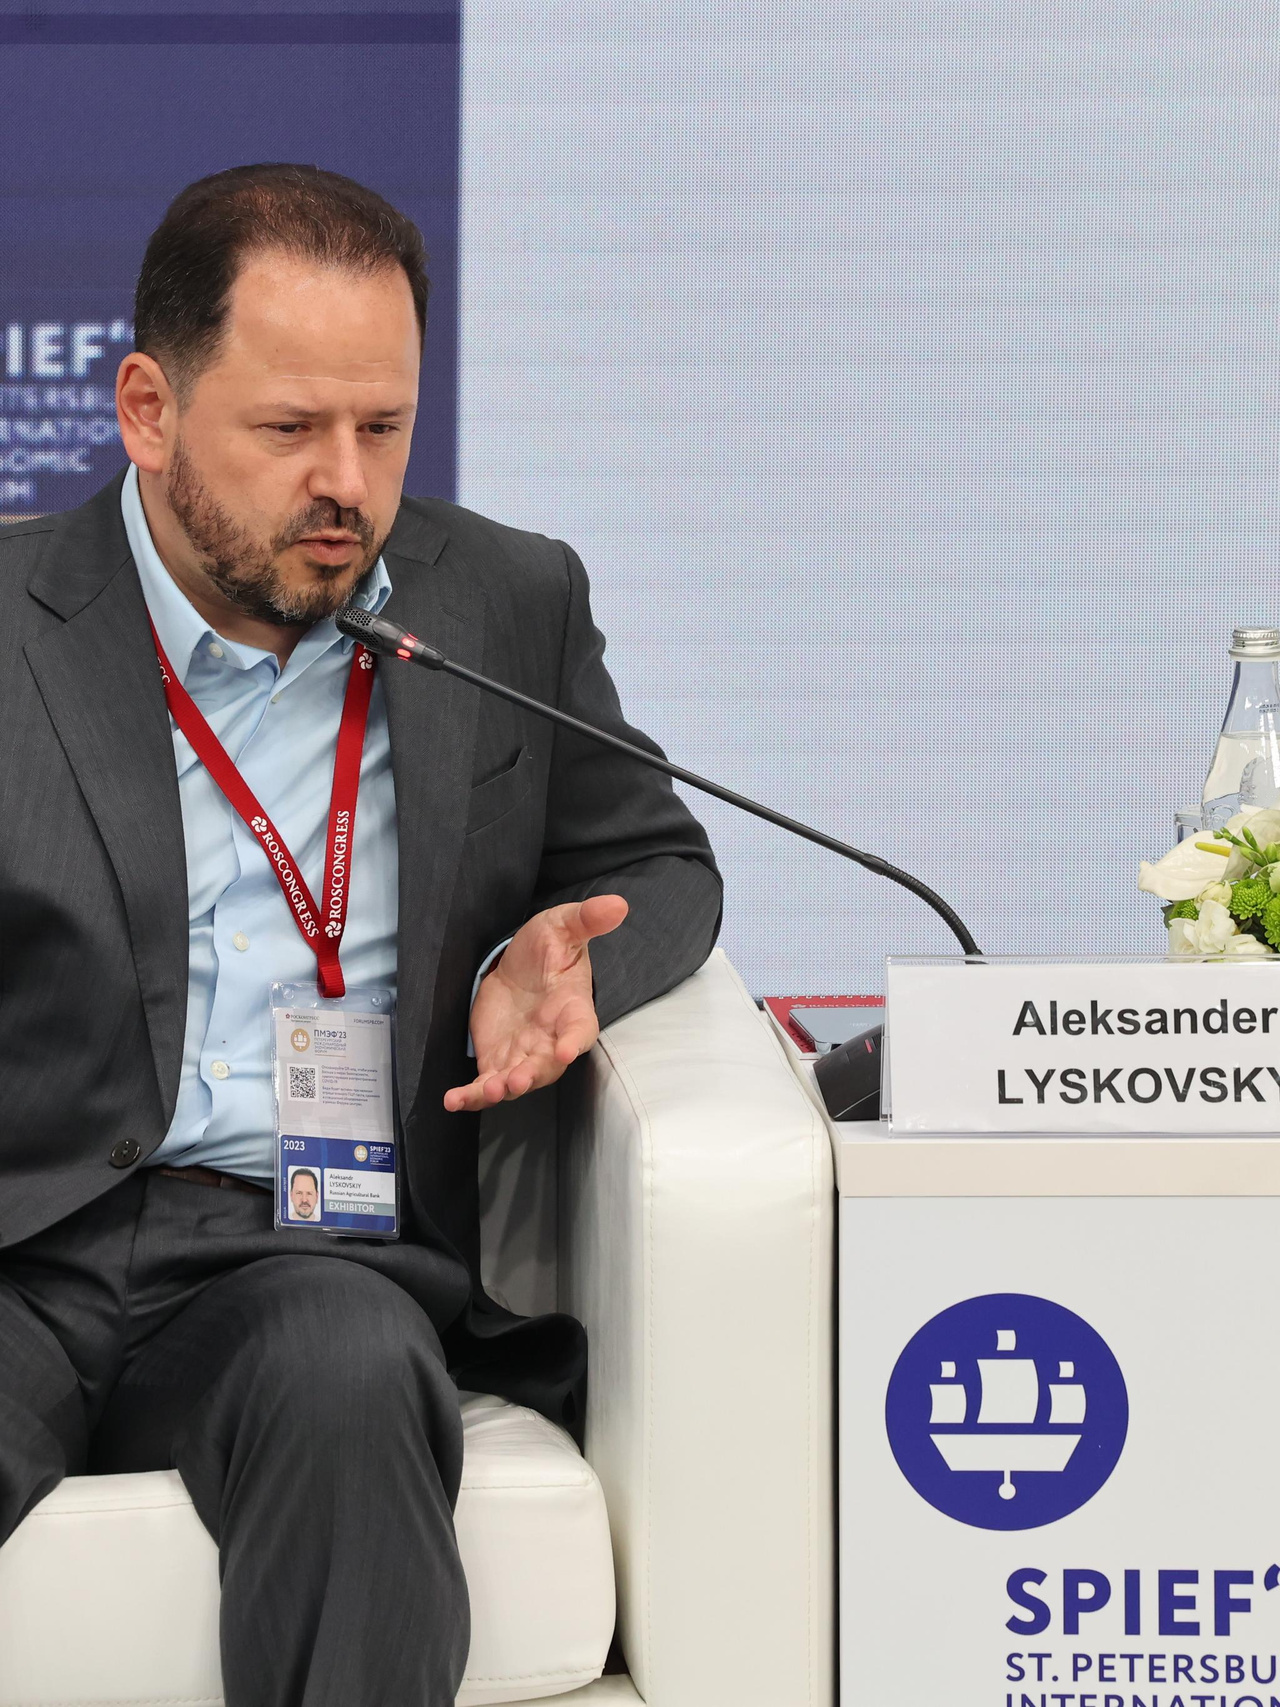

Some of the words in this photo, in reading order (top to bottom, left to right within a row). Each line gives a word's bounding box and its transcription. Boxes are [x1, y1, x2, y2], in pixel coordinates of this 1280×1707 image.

[329, 810, 350, 919] ROSCONGRESS
[262, 832, 319, 938] ROSCONGRESS
[1012, 998, 1279, 1036] Aleksander
[283, 1140, 305, 1151] 2023
[329, 1181, 362, 1189] LYSKOVSKIY
[328, 1201, 375, 1213] EXHIBITOR
[1006, 1652, 1059, 1682] ST.
[1072, 1653, 1277, 1684] PETERSBU
